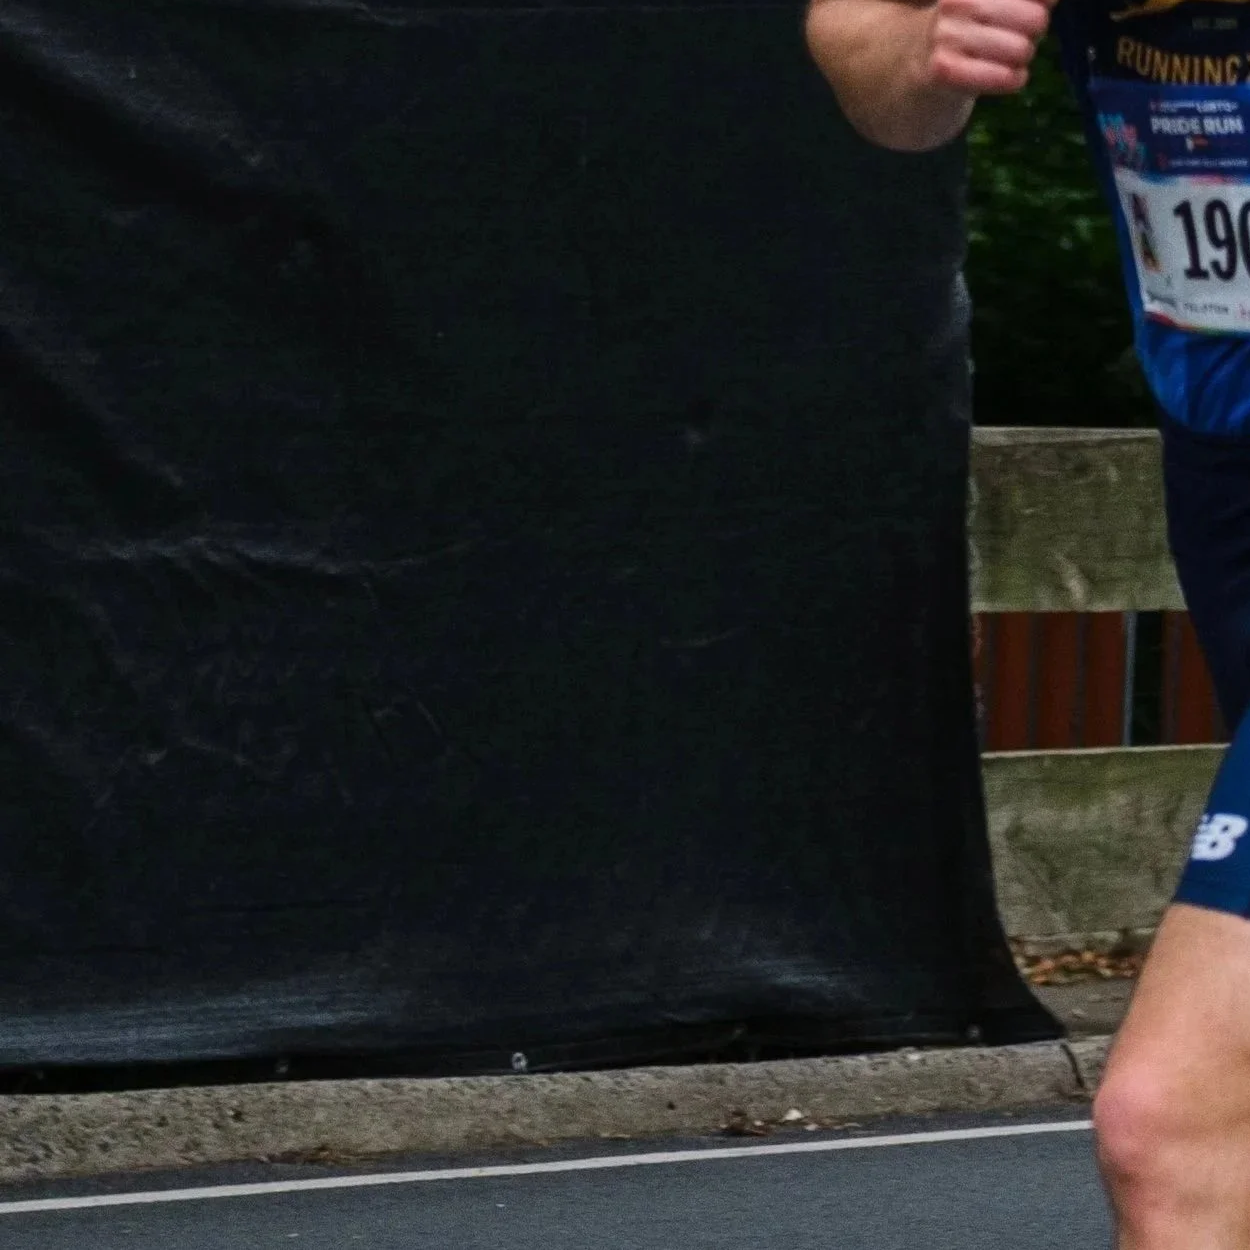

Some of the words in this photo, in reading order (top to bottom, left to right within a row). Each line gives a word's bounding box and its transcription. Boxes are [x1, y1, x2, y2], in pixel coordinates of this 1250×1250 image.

[1116, 36, 1241, 85] RUNNING
[1151, 115, 1202, 135] PRIDE
[1203, 114, 1245, 135] RUN
